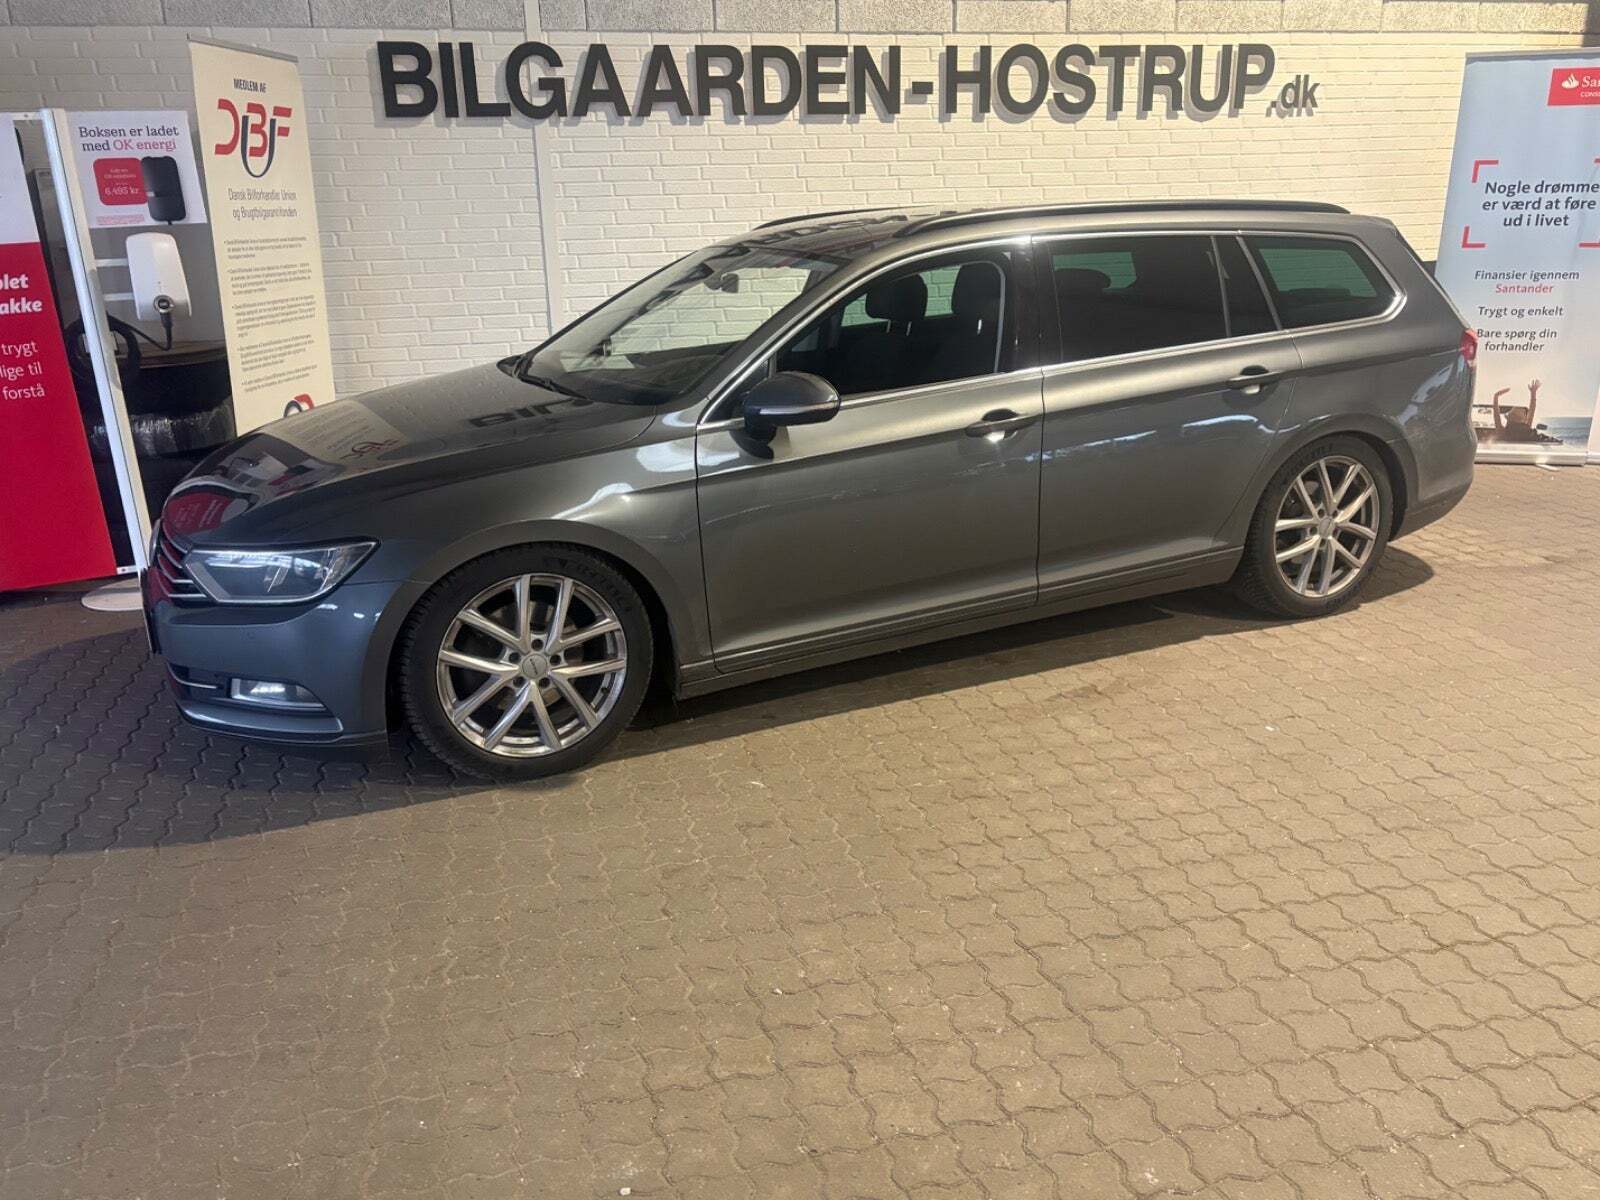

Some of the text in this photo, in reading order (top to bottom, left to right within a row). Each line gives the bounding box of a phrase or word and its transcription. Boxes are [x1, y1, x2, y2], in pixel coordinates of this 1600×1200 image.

[233, 78, 258, 92] MEDLEM
[376, 41, 1320, 119] BILGAARDEN-HOSTRUP.dk
[78, 125, 180, 138] Boksen er ladet
[81, 138, 177, 152] med OK energi
[1485, 180, 1600, 197] Nogle drømme
[1482, 196, 1597, 211] er værd at føre
[1503, 213, 1569, 227] ud i livet
[1474, 270, 1580, 283] Finansier igennem
[1495, 283, 1554, 294] Santander
[1478, 306, 1564, 318] Trygt og enkelt
[1477, 328, 1557, 341] Bare spørg din
[1, 340, 39, 359] trygt
[1484, 341, 1545, 351] forhandler
[28, 360, 43, 376] til
[2, 383, 45, 401] forstå
